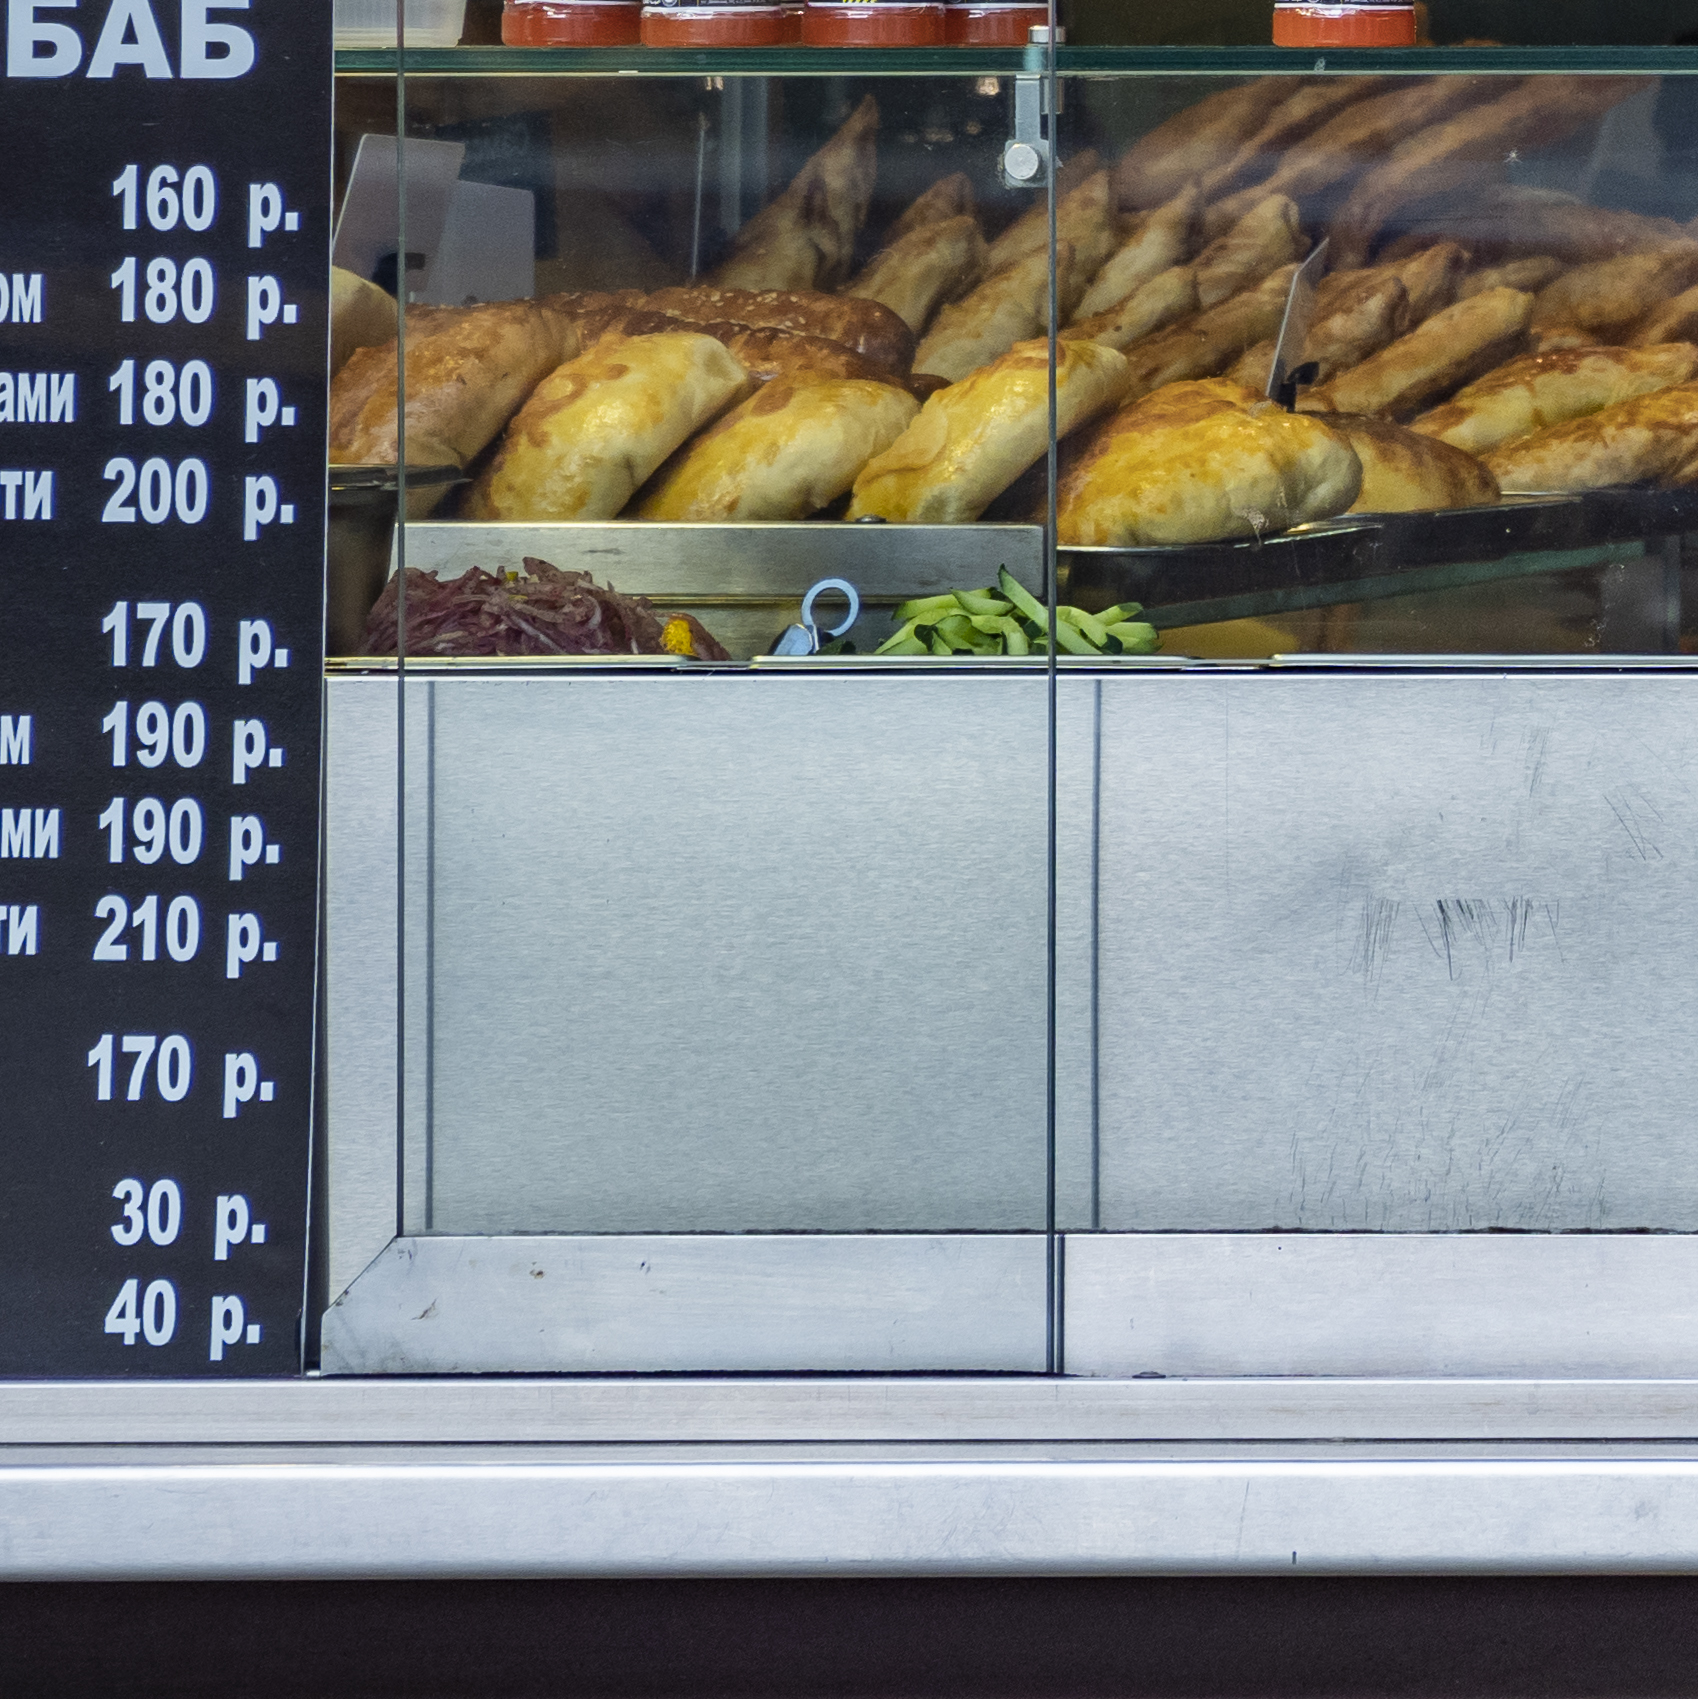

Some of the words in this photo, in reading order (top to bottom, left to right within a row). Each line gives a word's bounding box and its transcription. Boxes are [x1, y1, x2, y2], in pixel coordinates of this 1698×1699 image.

[113, 165, 215, 232] 160
[249, 183, 298, 247] р.
[111, 257, 213, 323] 180
[247, 276, 297, 340] р.
[110, 360, 211, 426] 180
[245, 378, 295, 442] р.
[102, 458, 207, 523] 200
[244, 476, 294, 540] р.
[103, 601, 205, 668] 170
[239, 620, 288, 684] р.
[103, 701, 205, 767] 190
[233, 719, 282, 784] р.
[99, 798, 202, 864] 190
[229, 816, 279, 880] р.
[93, 895, 199, 961] 210
[227, 913, 277, 978] р.
[88, 1034, 190, 1101] 170
[224, 1053, 273, 1118] р.
[111, 1179, 181, 1245] 30
[215, 1195, 265, 1260] р.
[105, 1279, 176, 1346] 40
[210, 1296, 260, 1360] р.
